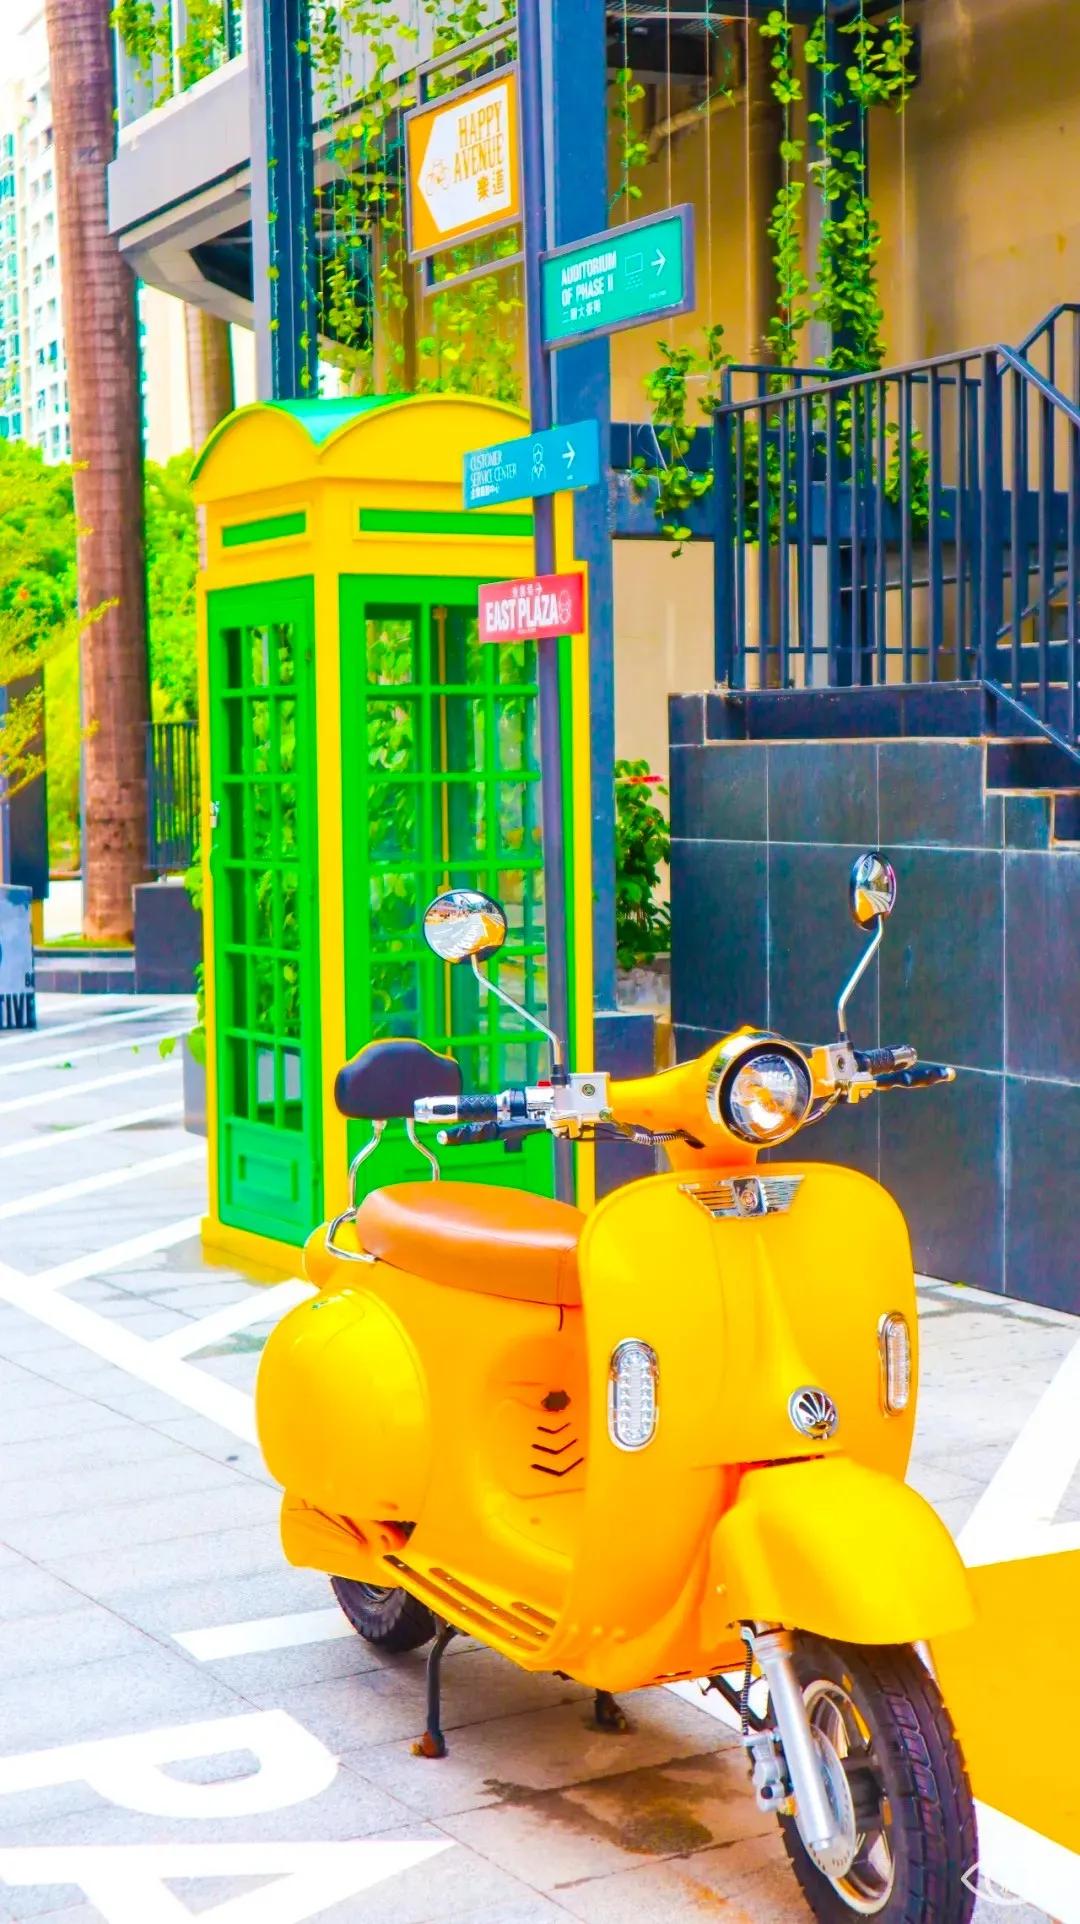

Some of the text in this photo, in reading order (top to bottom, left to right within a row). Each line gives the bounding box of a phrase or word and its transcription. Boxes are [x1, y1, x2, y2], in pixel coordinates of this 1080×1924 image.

[458, 101, 502, 148] HAPPY
[453, 134, 503, 183] AVENUE
[561, 251, 617, 286] AUDITORIUM
[561, 287, 573, 307] OF
[576, 276, 604, 301] PHASE
[470, 450, 503, 472] CUSTOMER
[470, 463, 517, 487] SERVICE CENTER
[485, 594, 560, 633] EAST PLAZA
